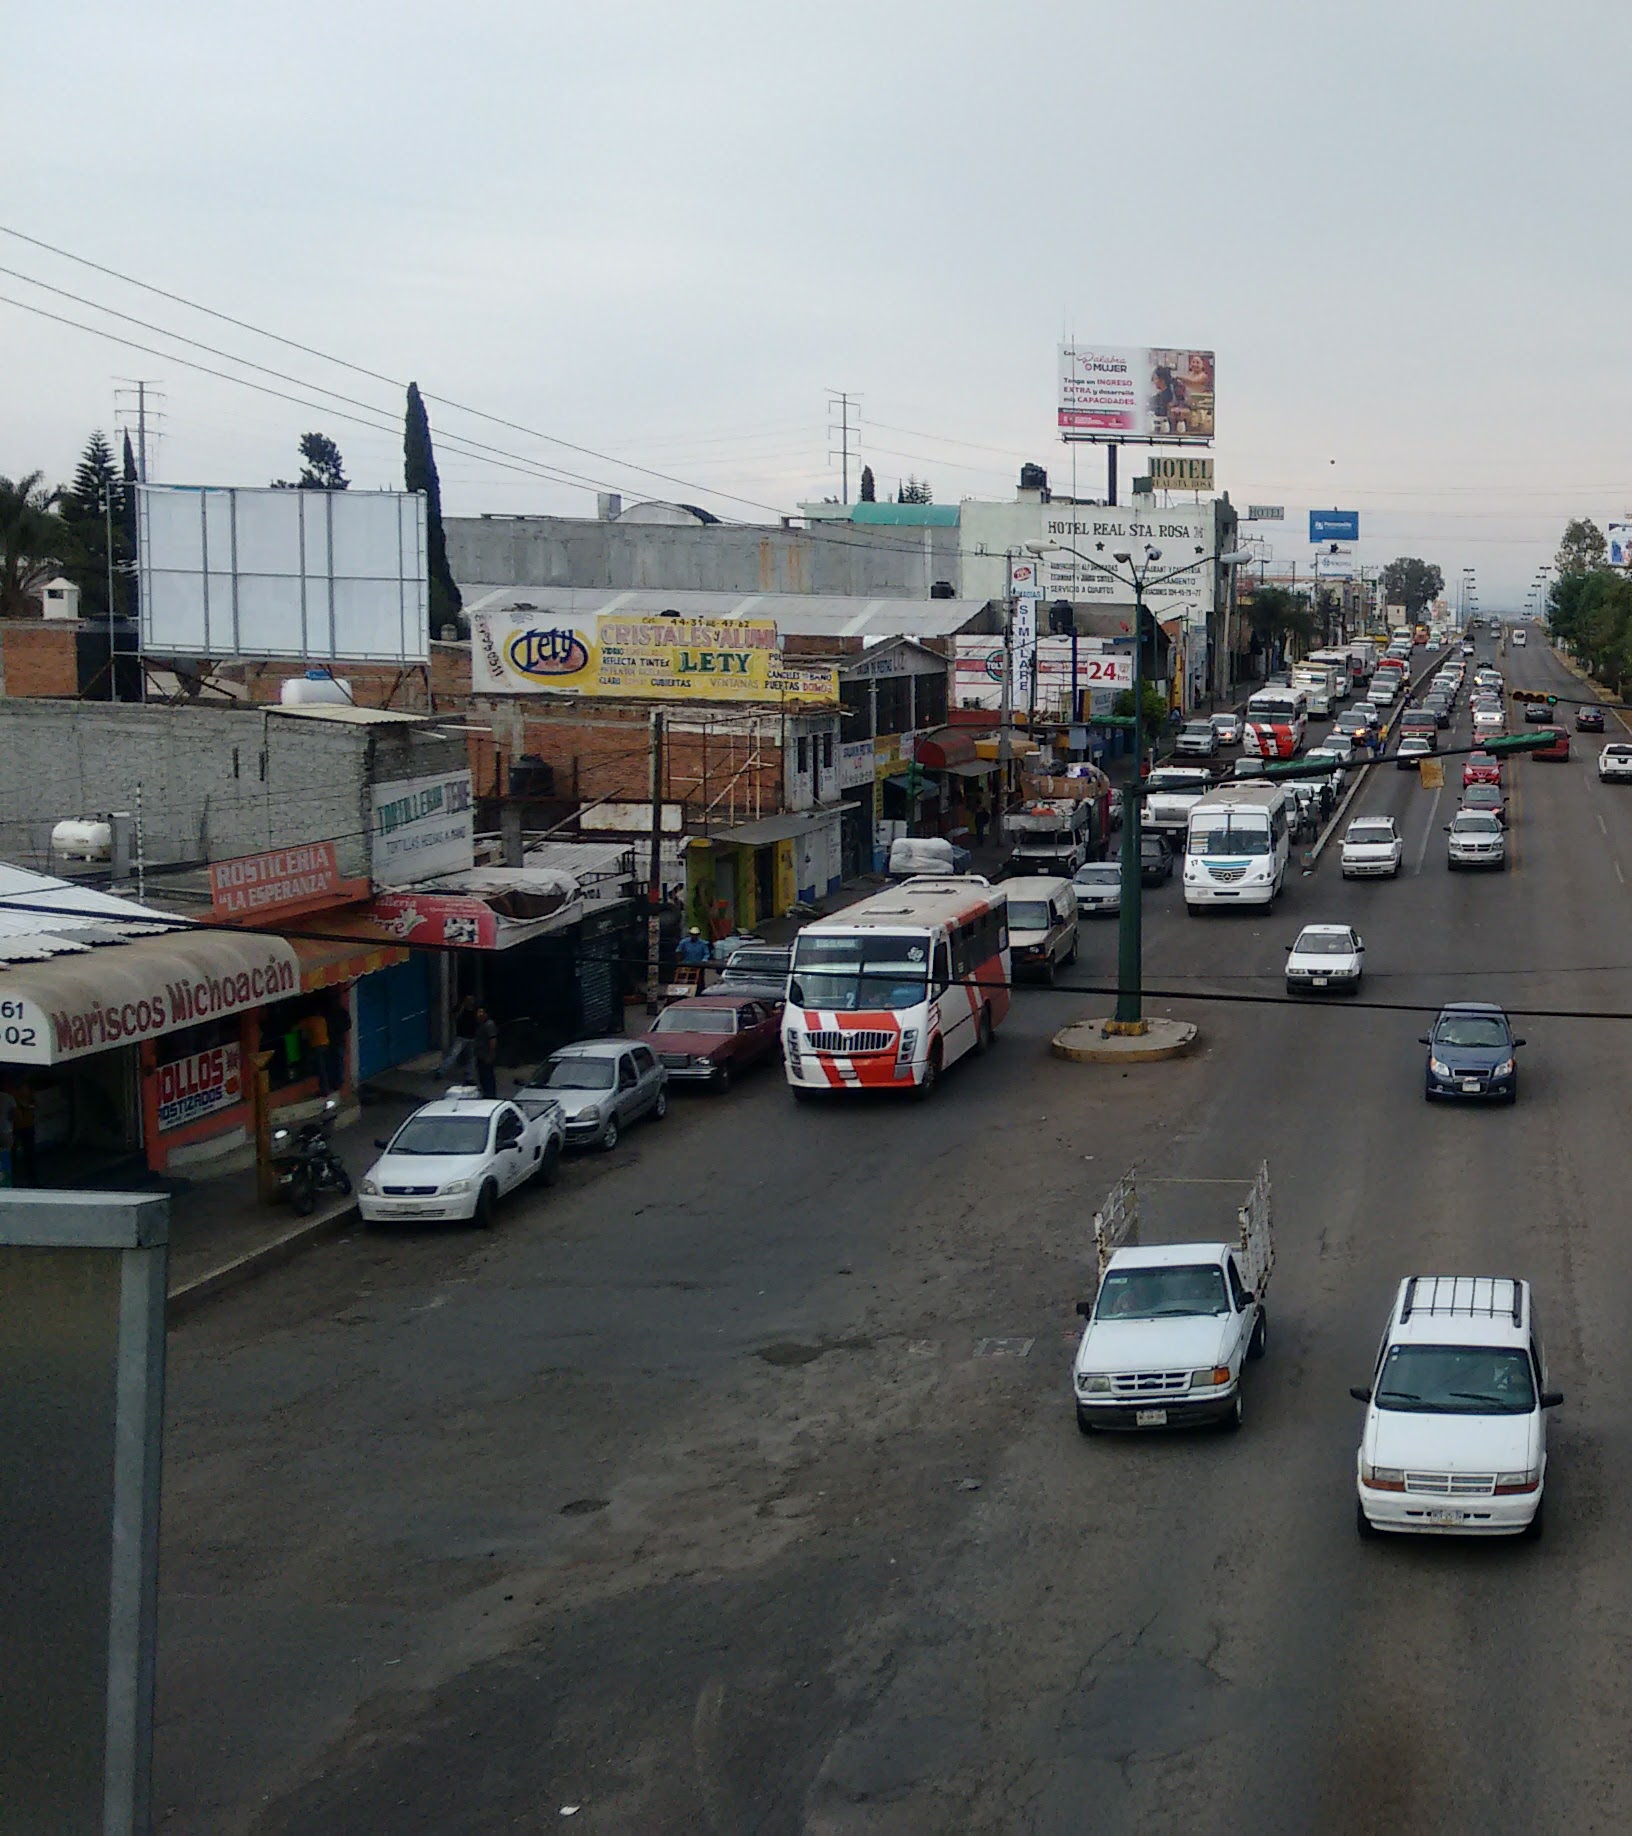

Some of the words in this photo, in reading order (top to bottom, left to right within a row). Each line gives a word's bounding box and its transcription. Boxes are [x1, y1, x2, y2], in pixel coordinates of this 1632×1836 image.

[1093, 363, 1127, 373] MUJER
[1063, 386, 1091, 394] EXTRA
[1150, 458, 1213, 479] HOTEL
[1191, 480, 1212, 489] ROSA
[1249, 507, 1283, 518] HOTEL
[1048, 521, 1090, 536] HOTEL
[1093, 523, 1126, 537] REAL
[1159, 525, 1190, 539] ROSA
[1050, 585, 1080, 594] SERVICIO
[601, 624, 714, 647] CRISTALES
[602, 657, 637, 666] REFLECTA
[678, 650, 753, 674] LETY
[1089, 661, 1116, 681] 24
[764, 680, 800, 691] PUERTAS
[216, 847, 330, 889] ROSTICERIA
[51, 996, 166, 1052] Mariscos
[166, 955, 294, 1025] Michoacán
[157, 1048, 224, 1105] OLLOS
[158, 1084, 224, 1121] OSTIZADOS
